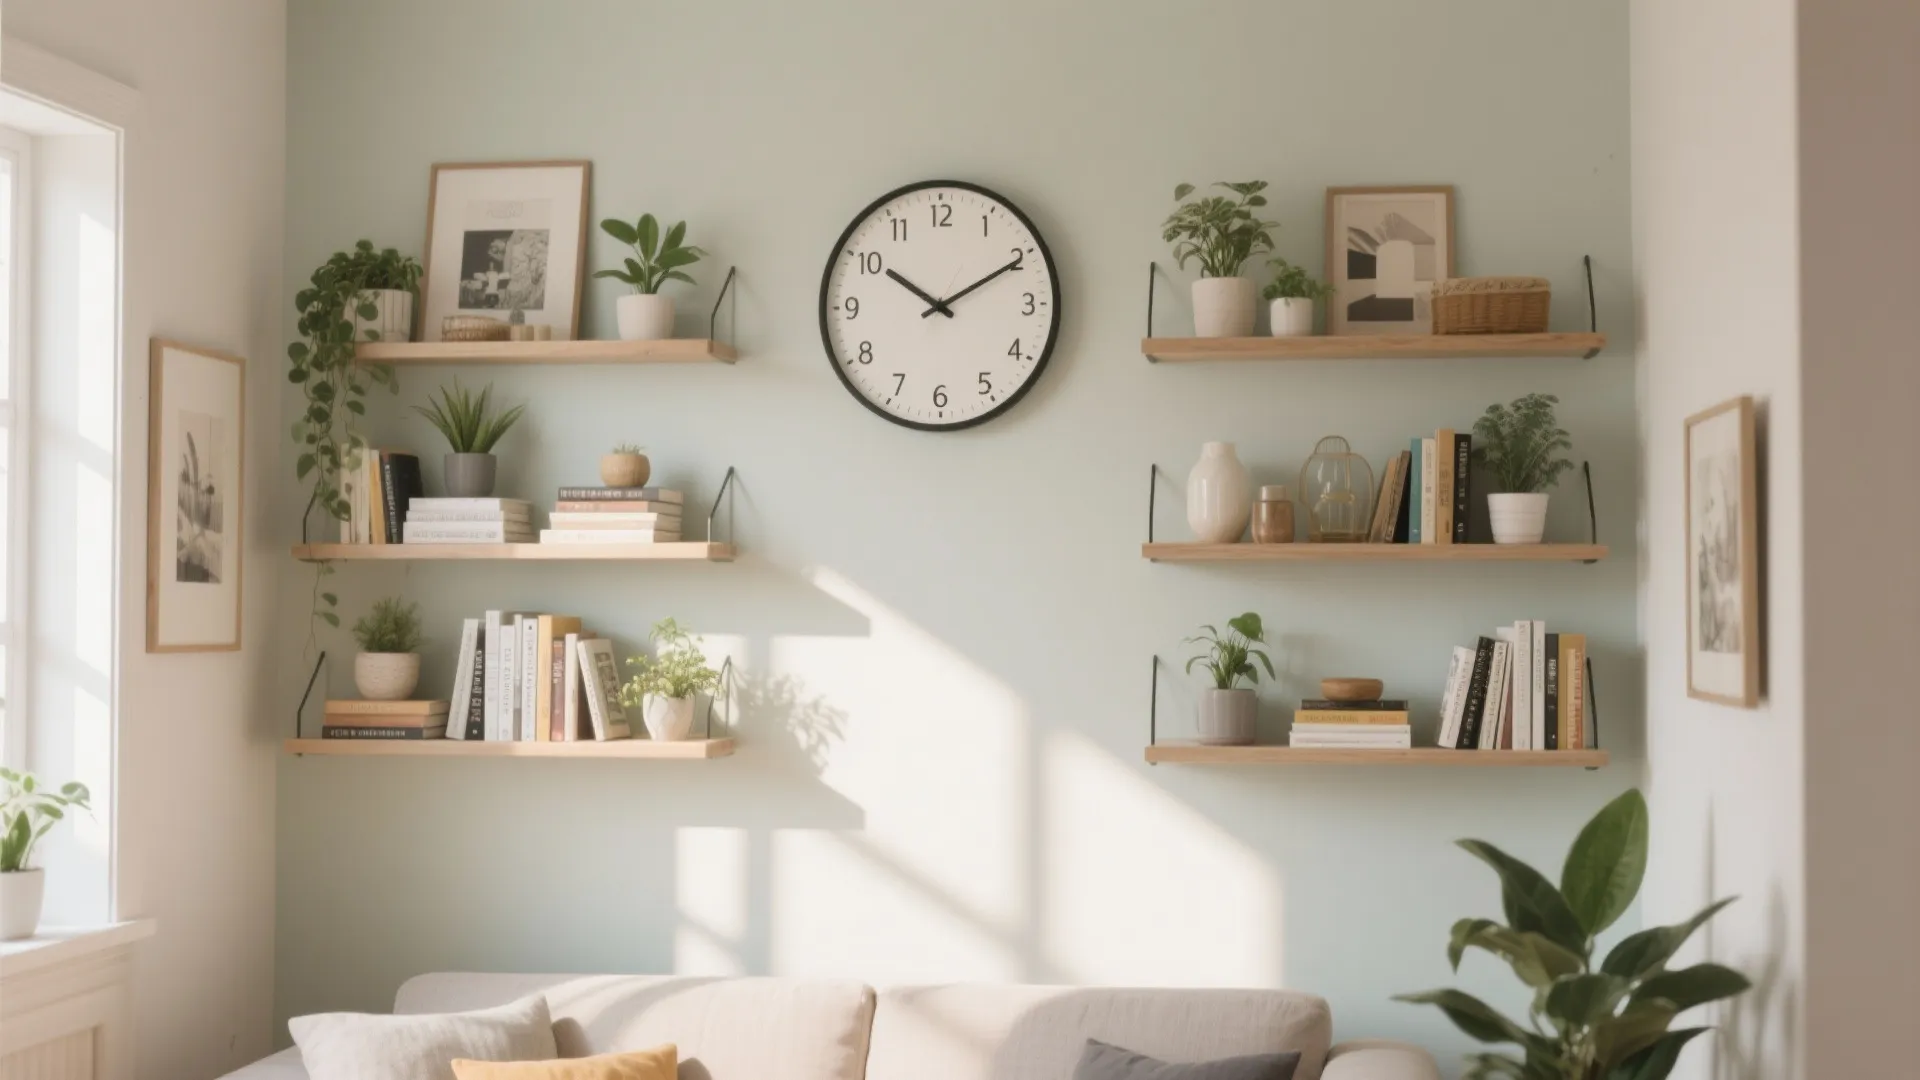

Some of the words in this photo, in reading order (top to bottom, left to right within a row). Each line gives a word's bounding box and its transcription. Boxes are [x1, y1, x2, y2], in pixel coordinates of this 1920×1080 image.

[931, 204, 952, 227] 12
[982, 215, 988, 237] 1
[890, 218, 907, 241] 11
[858, 252, 882, 274] 10
[1009, 248, 1024, 271] 2
[845, 297, 859, 320] 9
[1022, 293, 1035, 316] 3
[859, 341, 873, 364] 8
[1008, 338, 1023, 361] 4
[893, 373, 905, 396] 7
[979, 372, 992, 395] 5
[933, 385, 948, 407] 6
